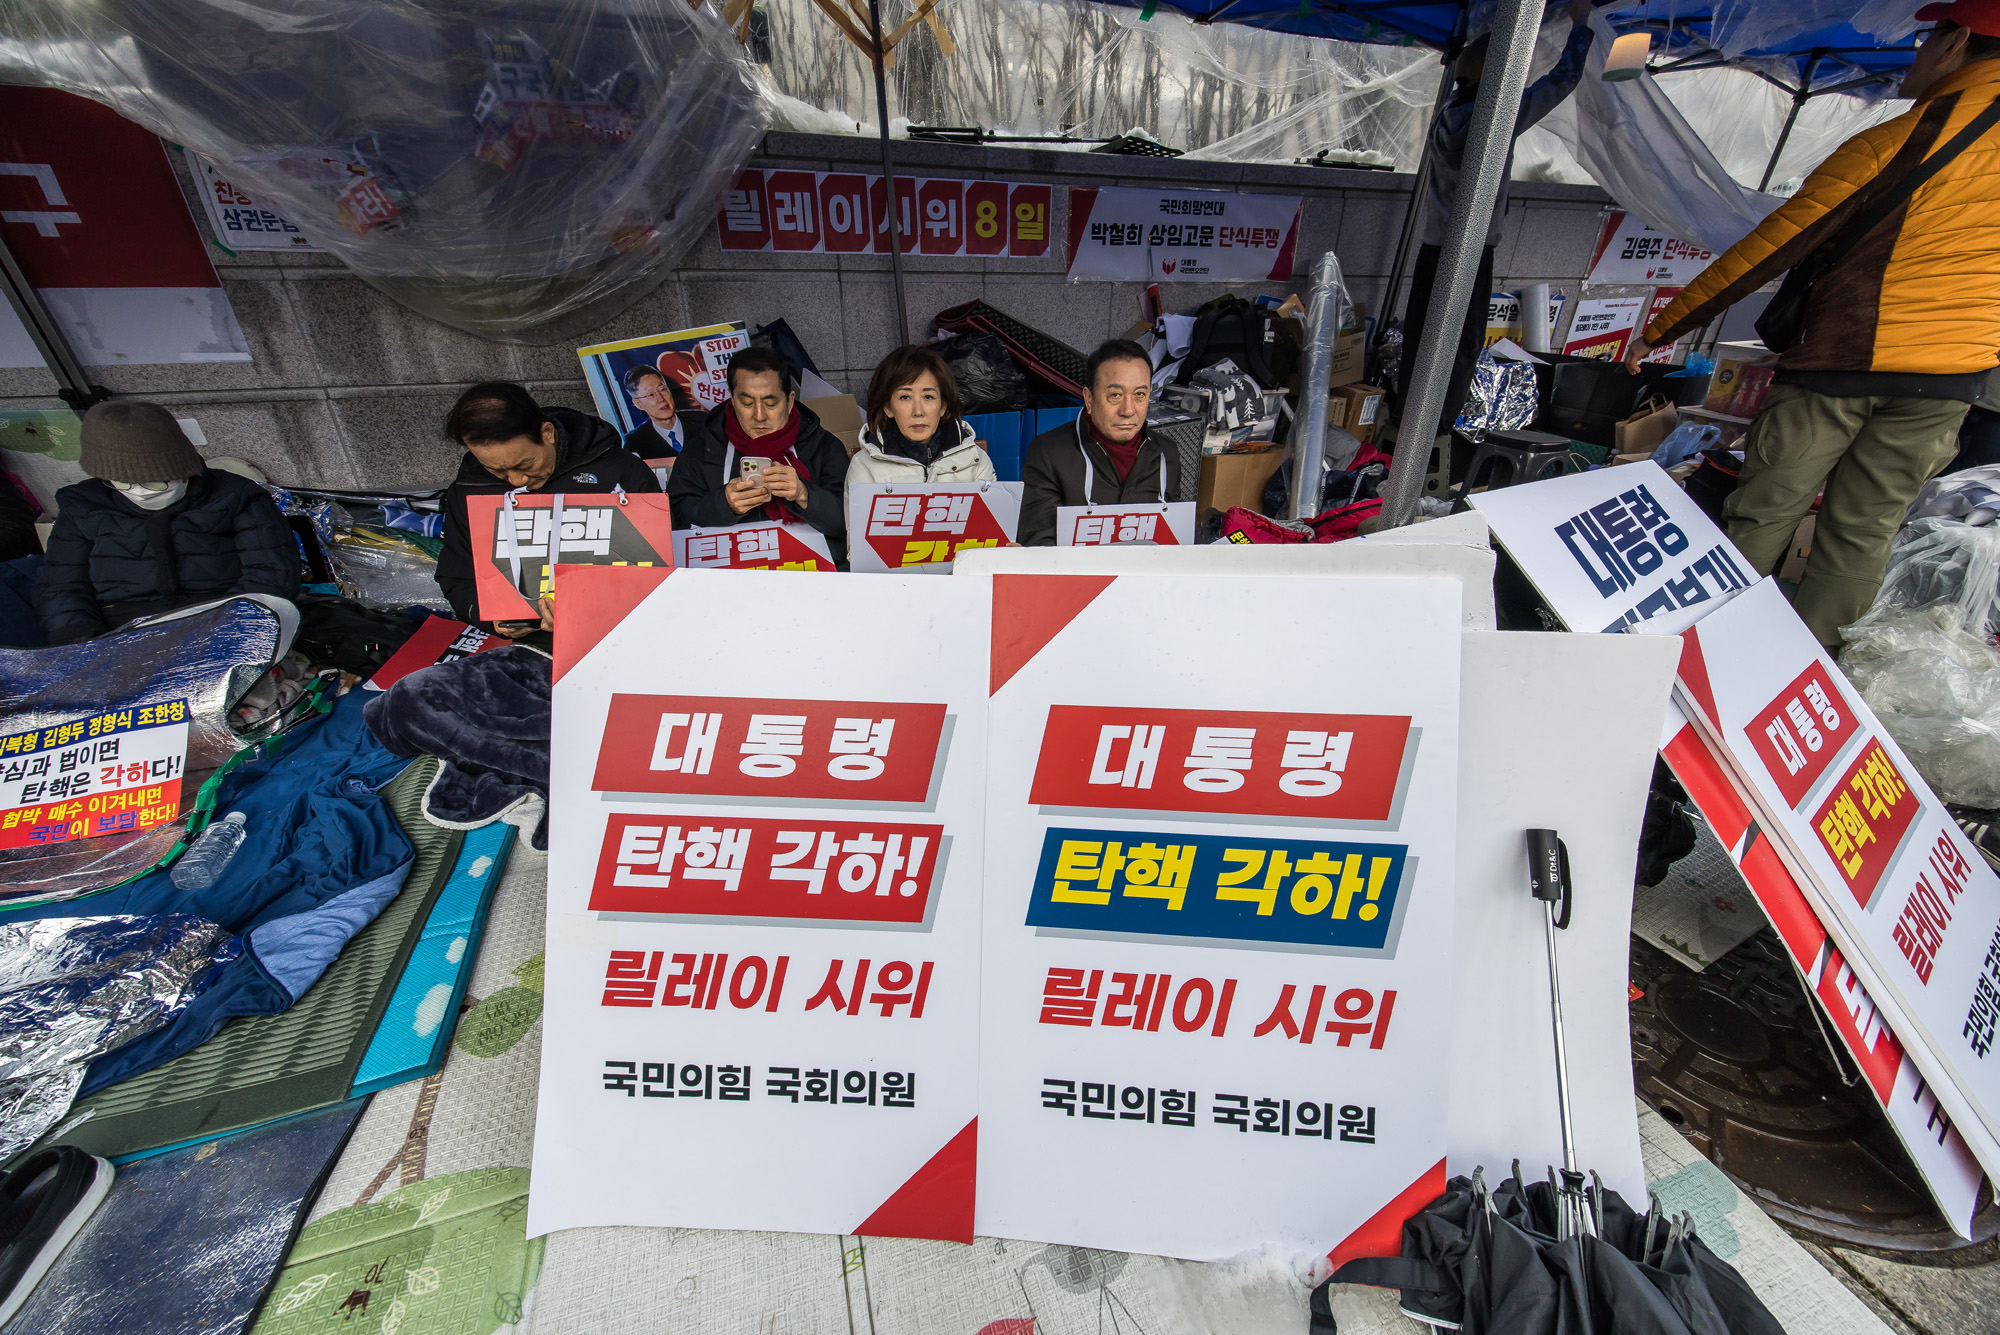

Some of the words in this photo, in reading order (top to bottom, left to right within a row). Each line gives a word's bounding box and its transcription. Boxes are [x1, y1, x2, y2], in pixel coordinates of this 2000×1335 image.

[724, 189, 864, 235] 릴레이
[1159, 199, 1225, 216] 국민희망연대
[1091, 222, 1143, 246] 박철희
[1149, 224, 1214, 247] 상임고문
[1219, 226, 1280, 249] 단식투쟁
[1620, 237, 1663, 260] 김영주
[706, 336, 740, 353] STOP
[714, 352, 735, 366] TH
[496, 508, 613, 558] 탄핵
[868, 494, 974, 537] 탄핵
[686, 529, 780, 568] 탄핵
[1553, 483, 1689, 600] 대통령
[43, 721, 84, 749] 김형두
[88, 710, 133, 736] 정형식
[137, 701, 185, 726] 조한창
[649, 712, 896, 781] 대통령
[1764, 678, 1841, 776] 대통령
[19, 771, 91, 804] 탄핵은
[100, 755, 182, 788] 각하다!
[59, 738, 121, 773] 법이면
[1088, 724, 1354, 797] 대통령
[1, 809, 42, 830] 협박
[47, 801, 83, 822] 매수
[88, 786, 162, 814] 이겨내면
[29, 818, 90, 842] 국민이
[96, 803, 176, 833] 보답한다!
[1820, 801, 1878, 881] 탄핵
[1849, 746, 1906, 823] 각하!
[612, 825, 752, 892] 탄핵
[769, 830, 929, 898] 각하!
[1050, 839, 1198, 911] 탄핵
[1215, 847, 1393, 922] 각하!
[1892, 870, 1954, 987] 릴레이
[1928, 828, 1972, 903] 시위
[601, 950, 789, 1013] 릴레이
[804, 958, 935, 1019] 시위
[1038, 967, 1238, 1038] 릴레이
[1253, 983, 1398, 1051] 시위
[602, 1060, 751, 1102] 국민의힘
[765, 1066, 916, 1108] 국회의원
[1040, 1078, 1197, 1128] 국민의힘
[1212, 1093, 1376, 1145] 국회의원
